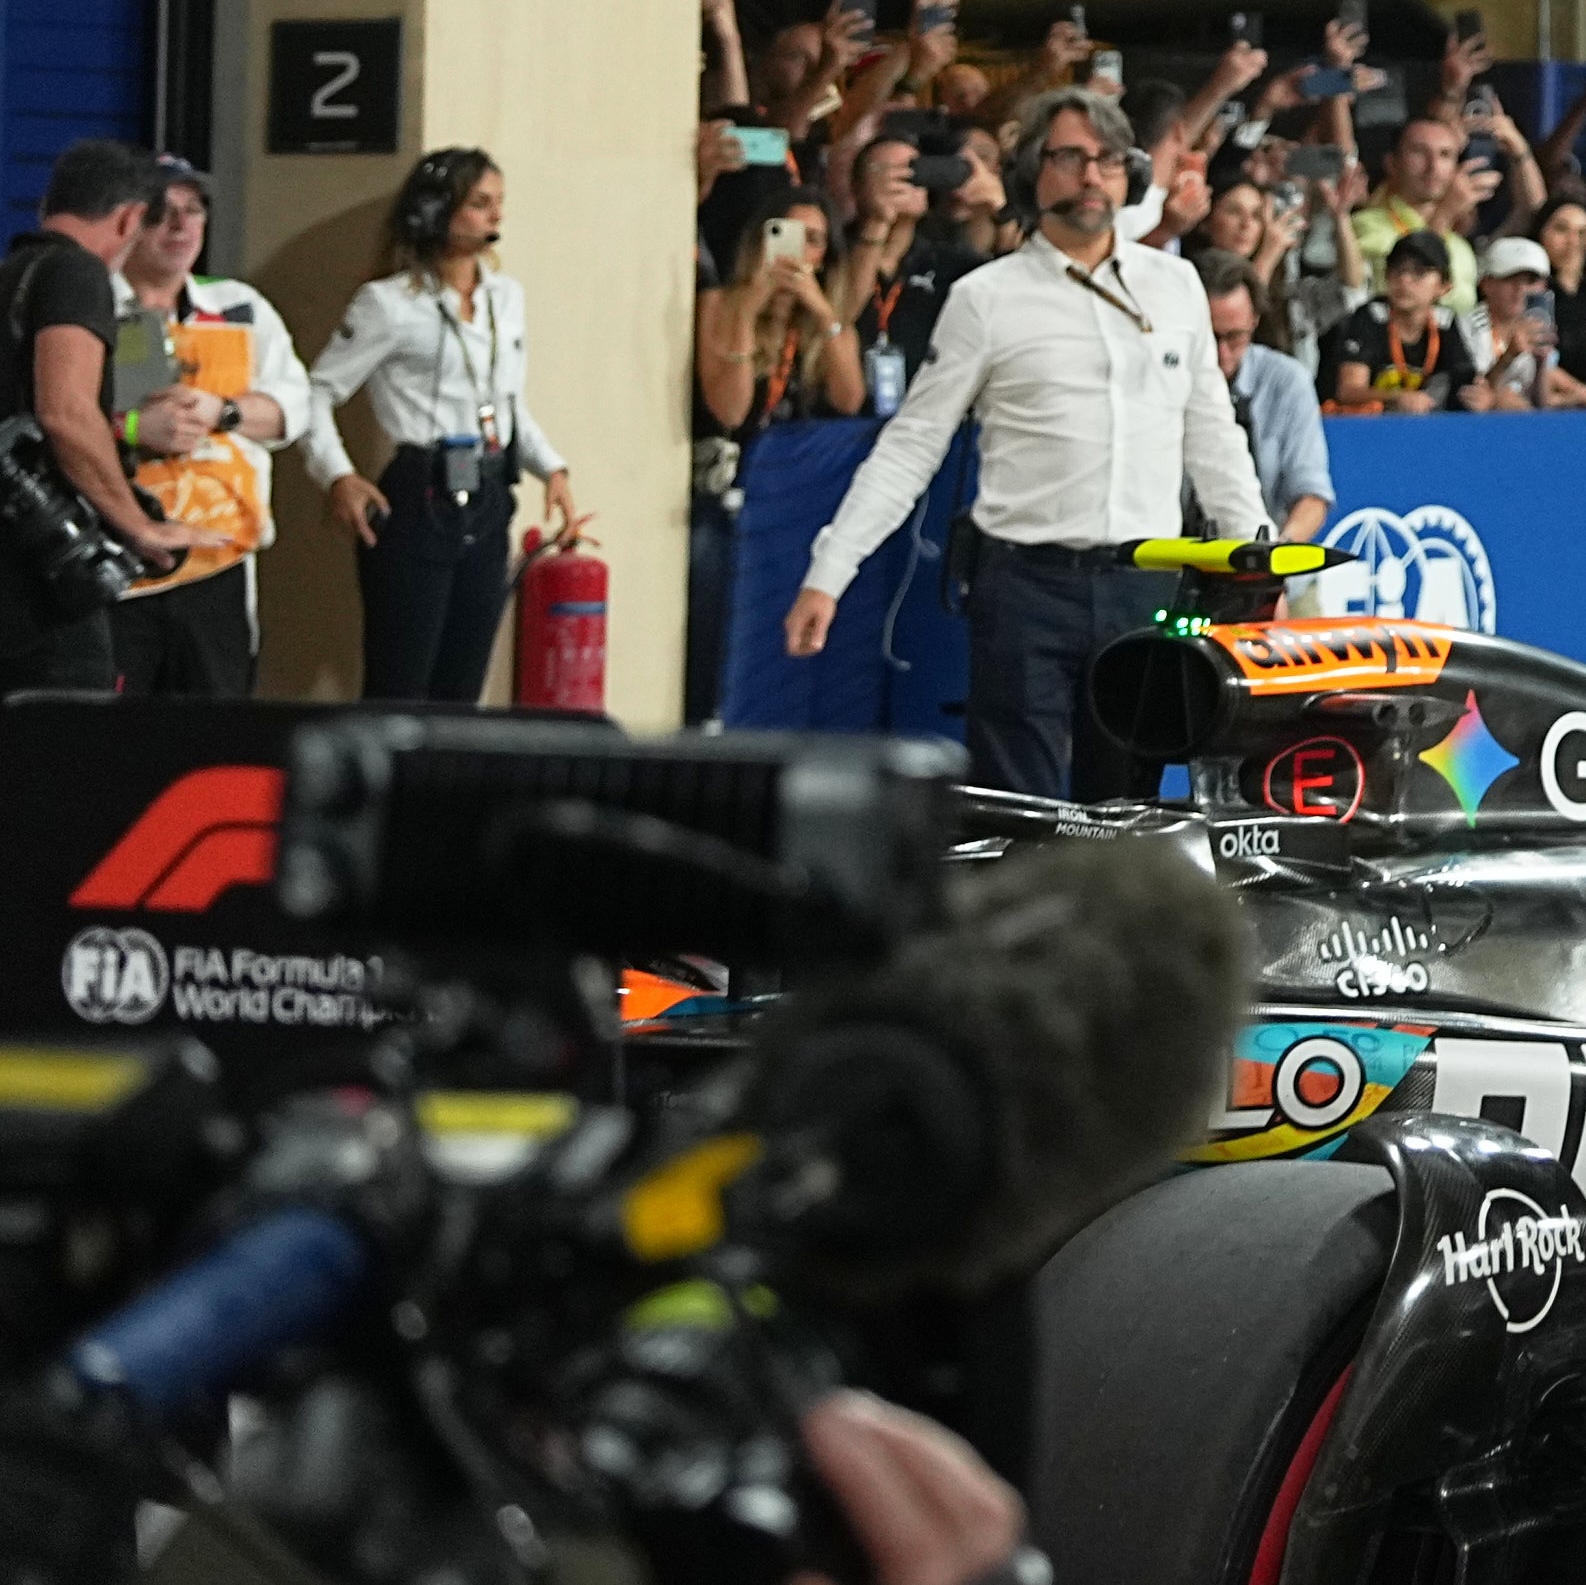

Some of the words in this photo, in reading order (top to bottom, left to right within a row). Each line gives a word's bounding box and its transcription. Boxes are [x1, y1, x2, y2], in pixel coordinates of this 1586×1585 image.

[311, 52, 361, 119] 2
[1219, 825, 1281, 858] okta
[71, 947, 155, 1002] FIA
[174, 946, 227, 984] FIA
[231, 949, 366, 988] Formula
[174, 984, 268, 1022] World
[1515, 1203, 1586, 1277] Rock
